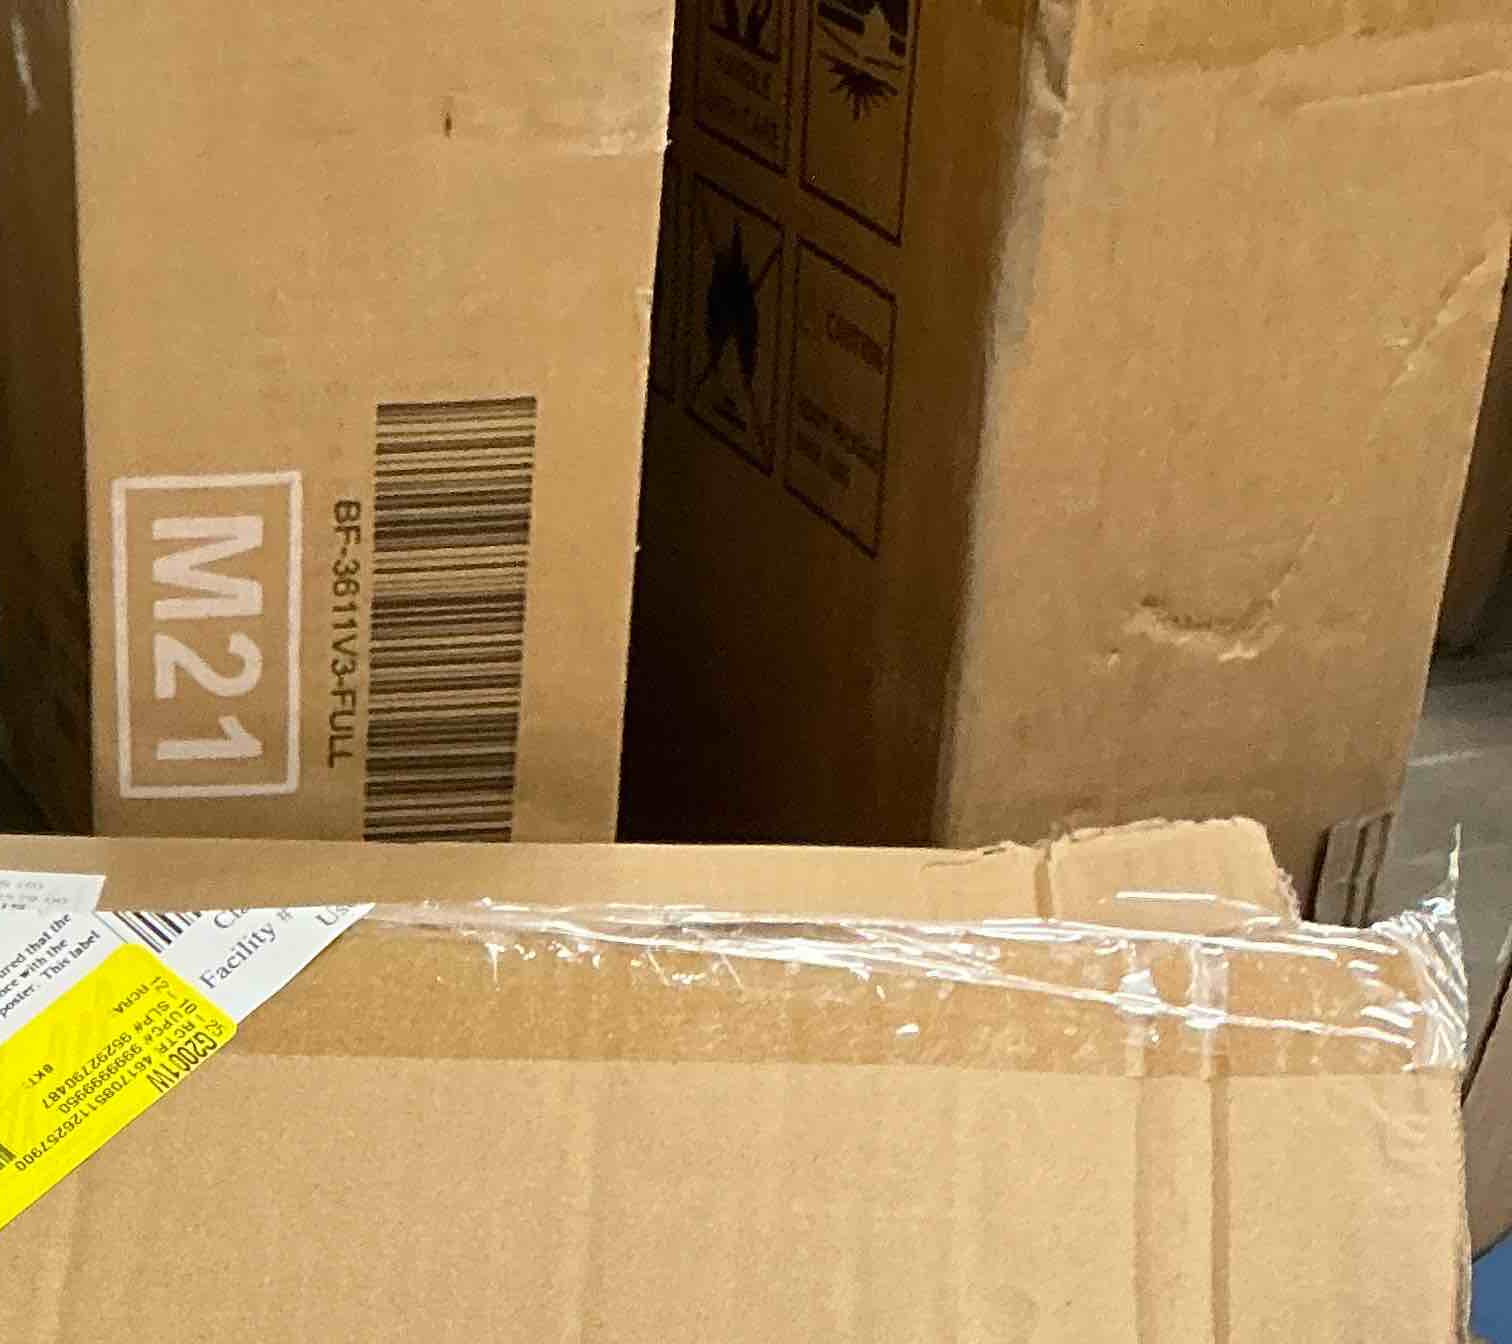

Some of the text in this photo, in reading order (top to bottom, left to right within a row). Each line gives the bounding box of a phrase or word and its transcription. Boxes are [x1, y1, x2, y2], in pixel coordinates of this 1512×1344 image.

[152, 515, 263, 760] M21
[328, 500, 361, 769] BF-3611V3-FULL
[18, 957, 47, 978] with
[45, 938, 67, 957] the
[24, 931, 51, 955] that
[49, 913, 71, 933] the
[39, 957, 70, 979] This
[68, 929, 100, 959] label
[200, 921, 278, 989] Facility
